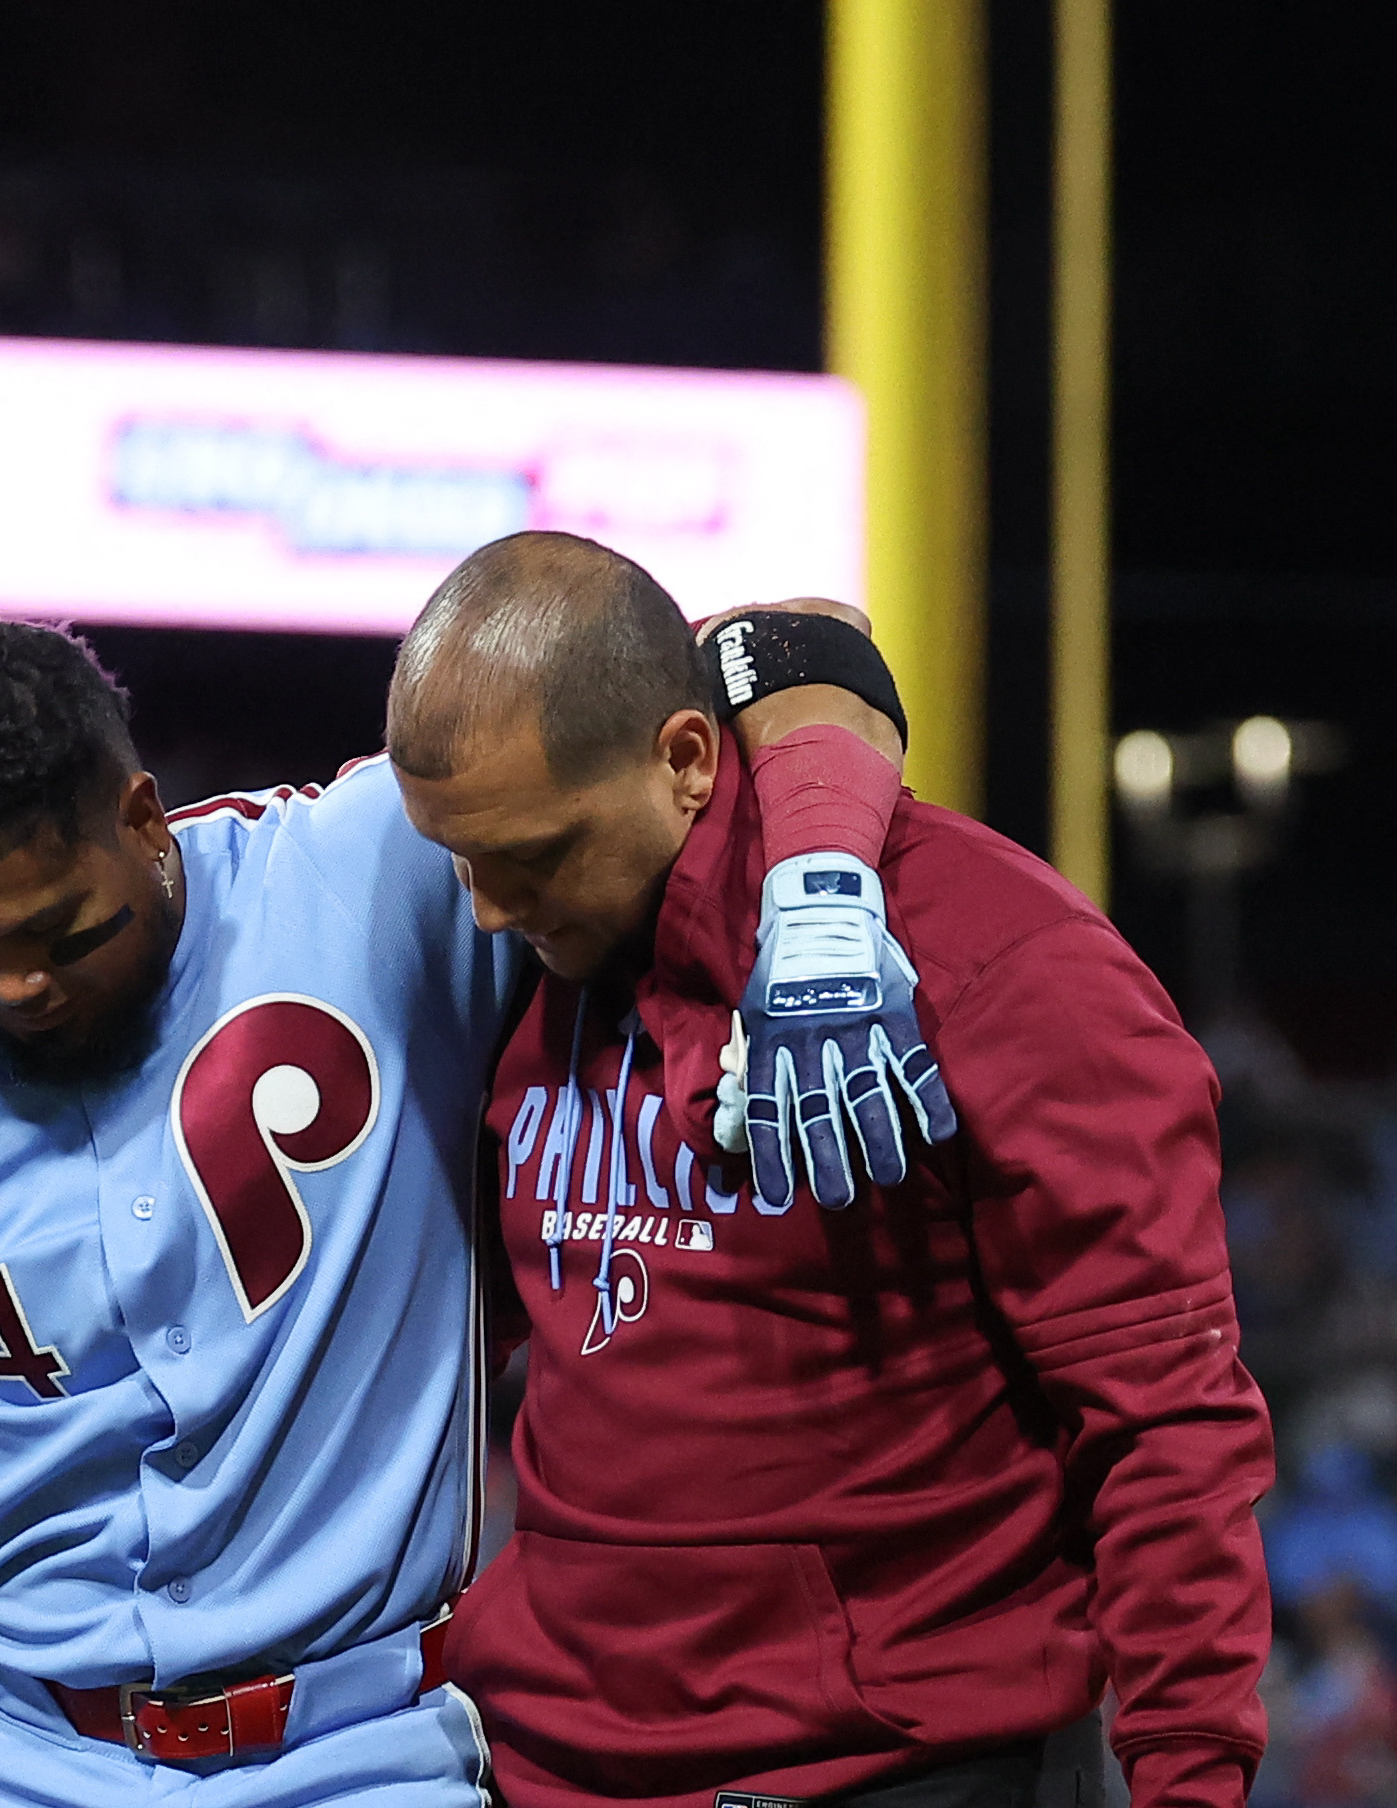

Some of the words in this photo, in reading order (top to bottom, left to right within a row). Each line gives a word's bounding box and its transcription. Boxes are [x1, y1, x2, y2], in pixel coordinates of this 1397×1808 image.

[716, 620, 759, 706] Franklin
[170, 992, 380, 1324] P
[506, 1086, 794, 1216] PHILLI
